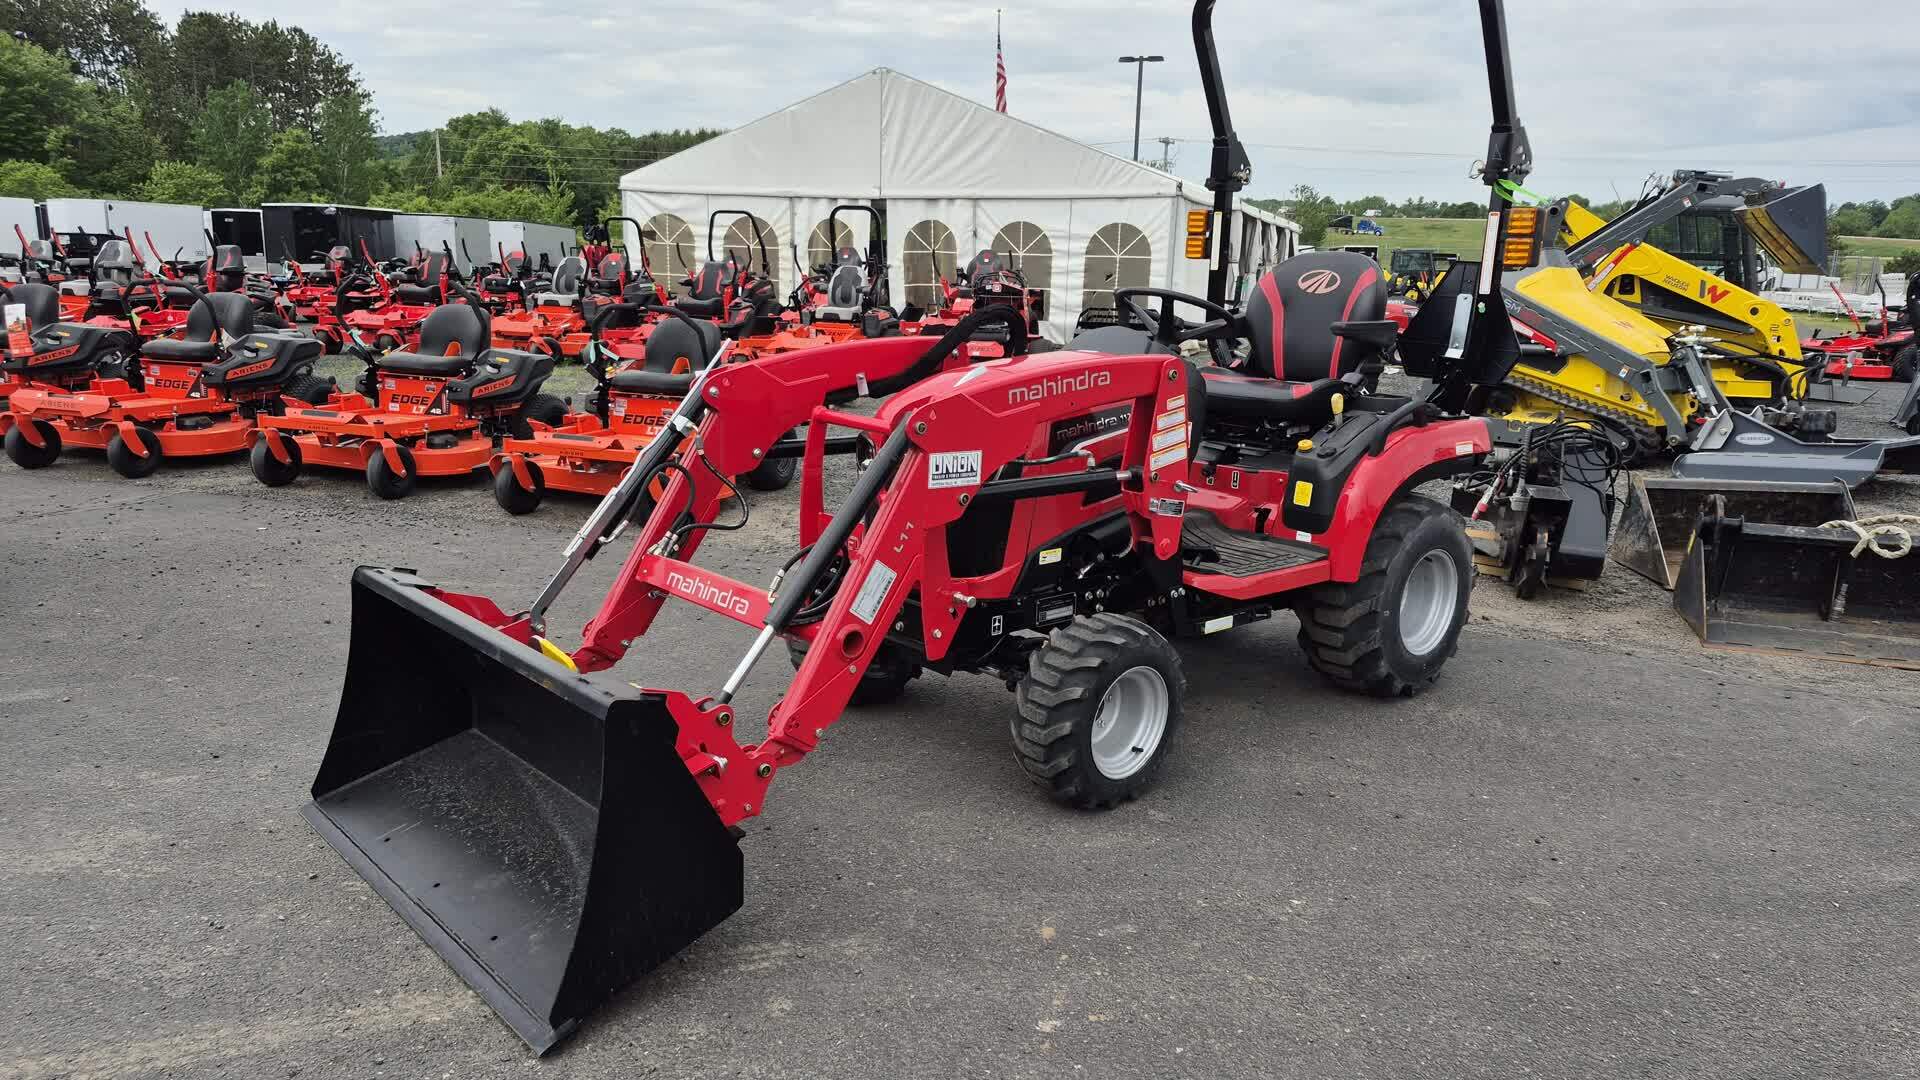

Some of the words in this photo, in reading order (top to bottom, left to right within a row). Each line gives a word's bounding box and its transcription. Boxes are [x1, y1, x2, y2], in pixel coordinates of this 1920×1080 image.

[231, 364, 270, 376] ARIENS
[155, 378, 190, 390] EDGE
[477, 379, 511, 394] ARIENS
[1008, 370, 1111, 404] mahindra
[391, 393, 430, 406] EDGE
[412, 405, 427, 415] LT
[623, 414, 668, 426] EDGE
[1056, 416, 1118, 441] mahindra
[931, 453, 979, 474] UNION
[666, 572, 750, 615] mahindra
